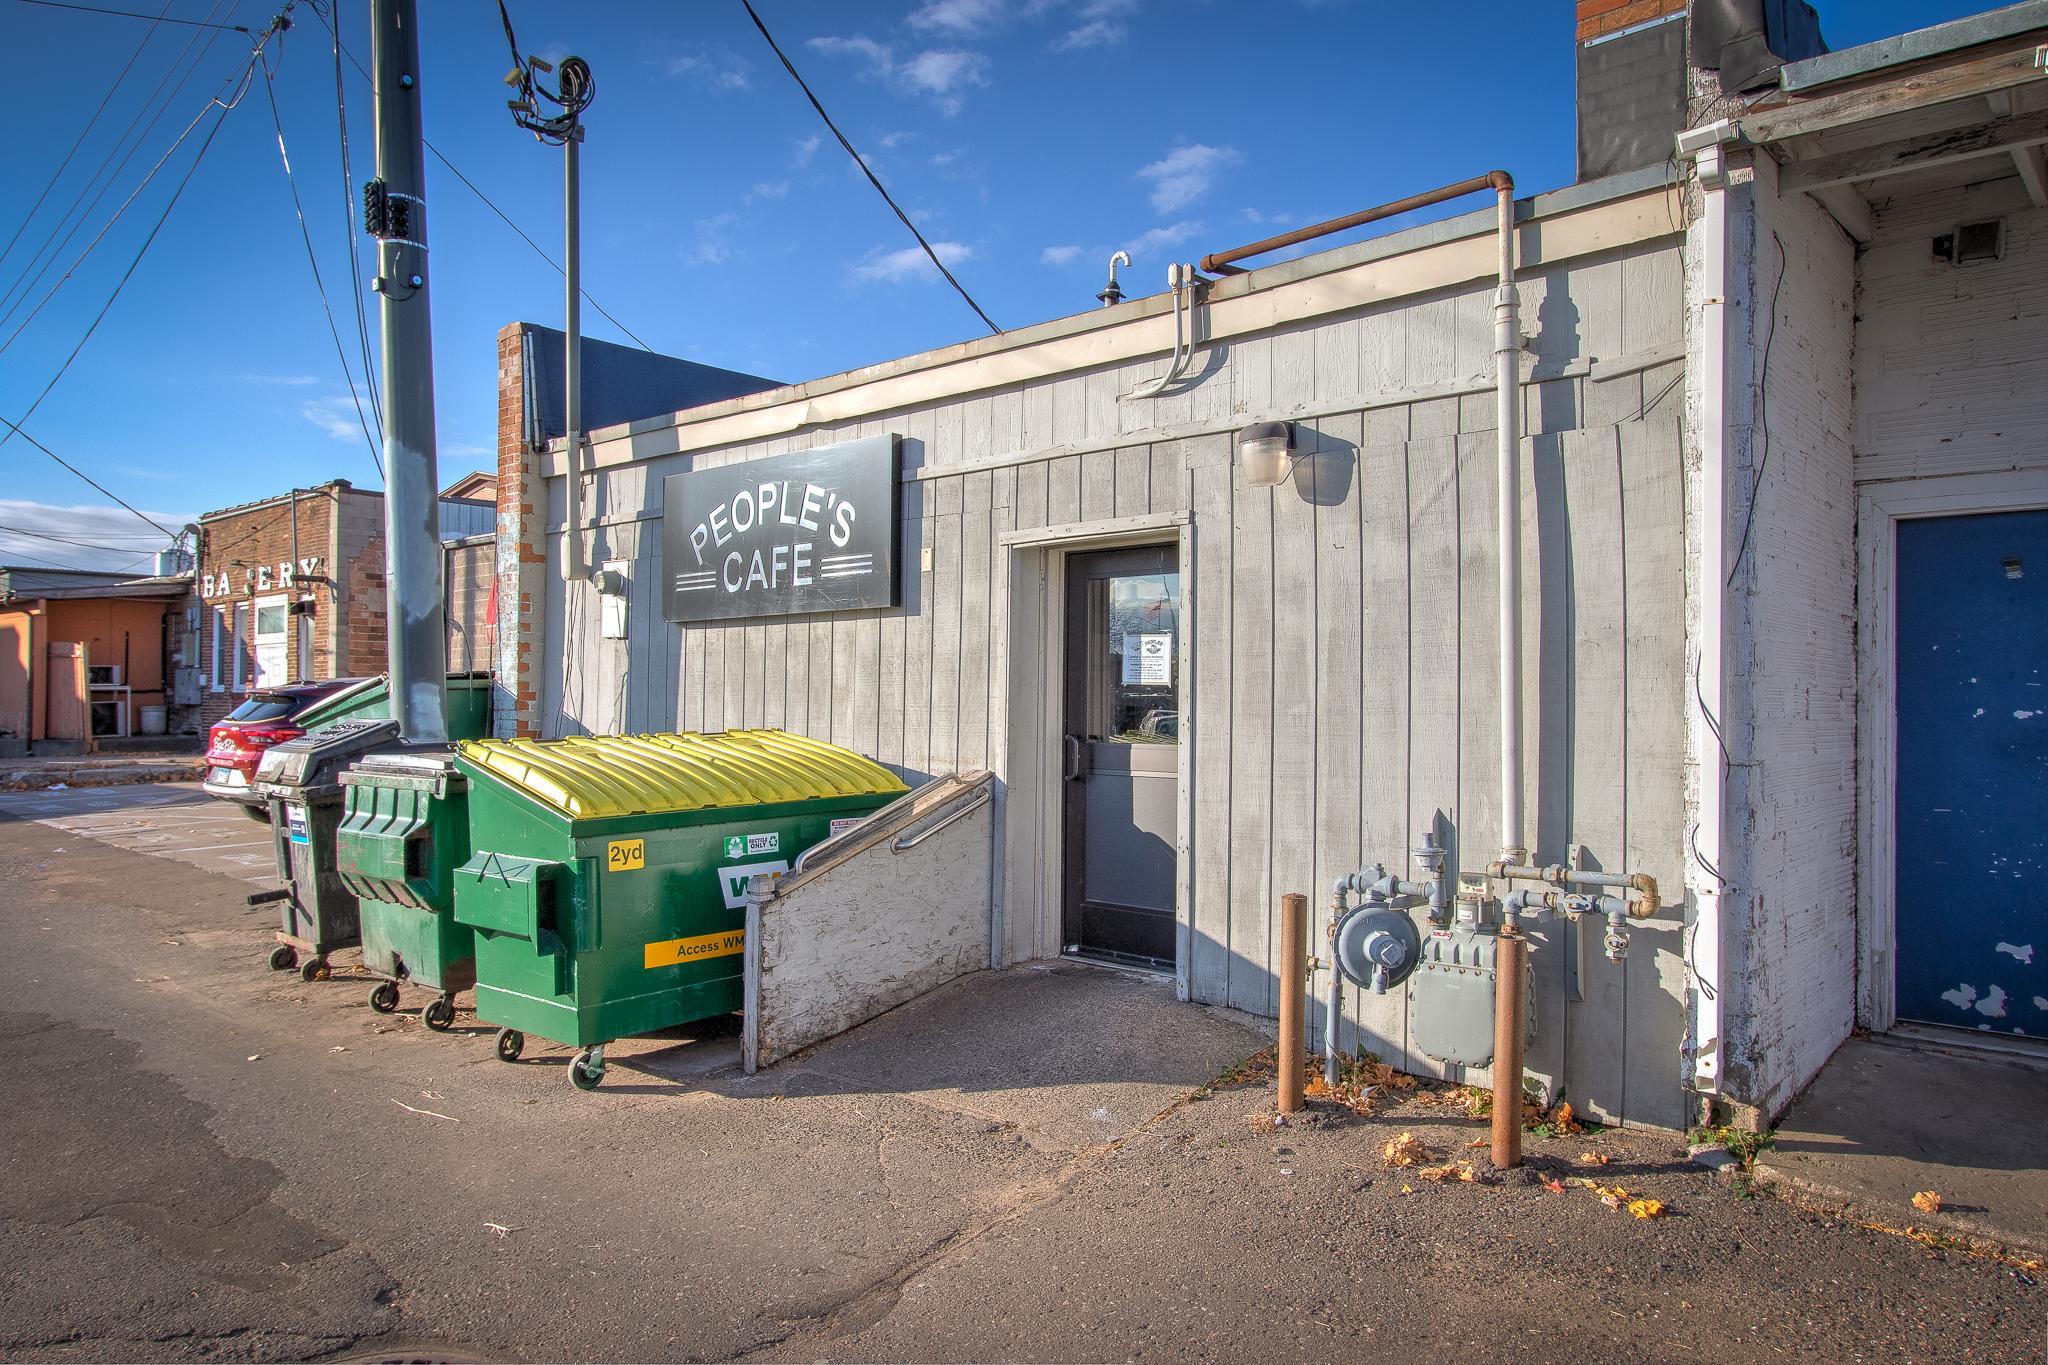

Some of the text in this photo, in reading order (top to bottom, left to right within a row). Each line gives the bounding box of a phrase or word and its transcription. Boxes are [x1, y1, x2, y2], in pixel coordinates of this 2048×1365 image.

[688, 481, 856, 566] PEOPLE'S
[203, 558, 318, 598] BAERY
[723, 543, 813, 593] CAFE
[611, 844, 642, 865] 2yd
[677, 943, 720, 957] Access
